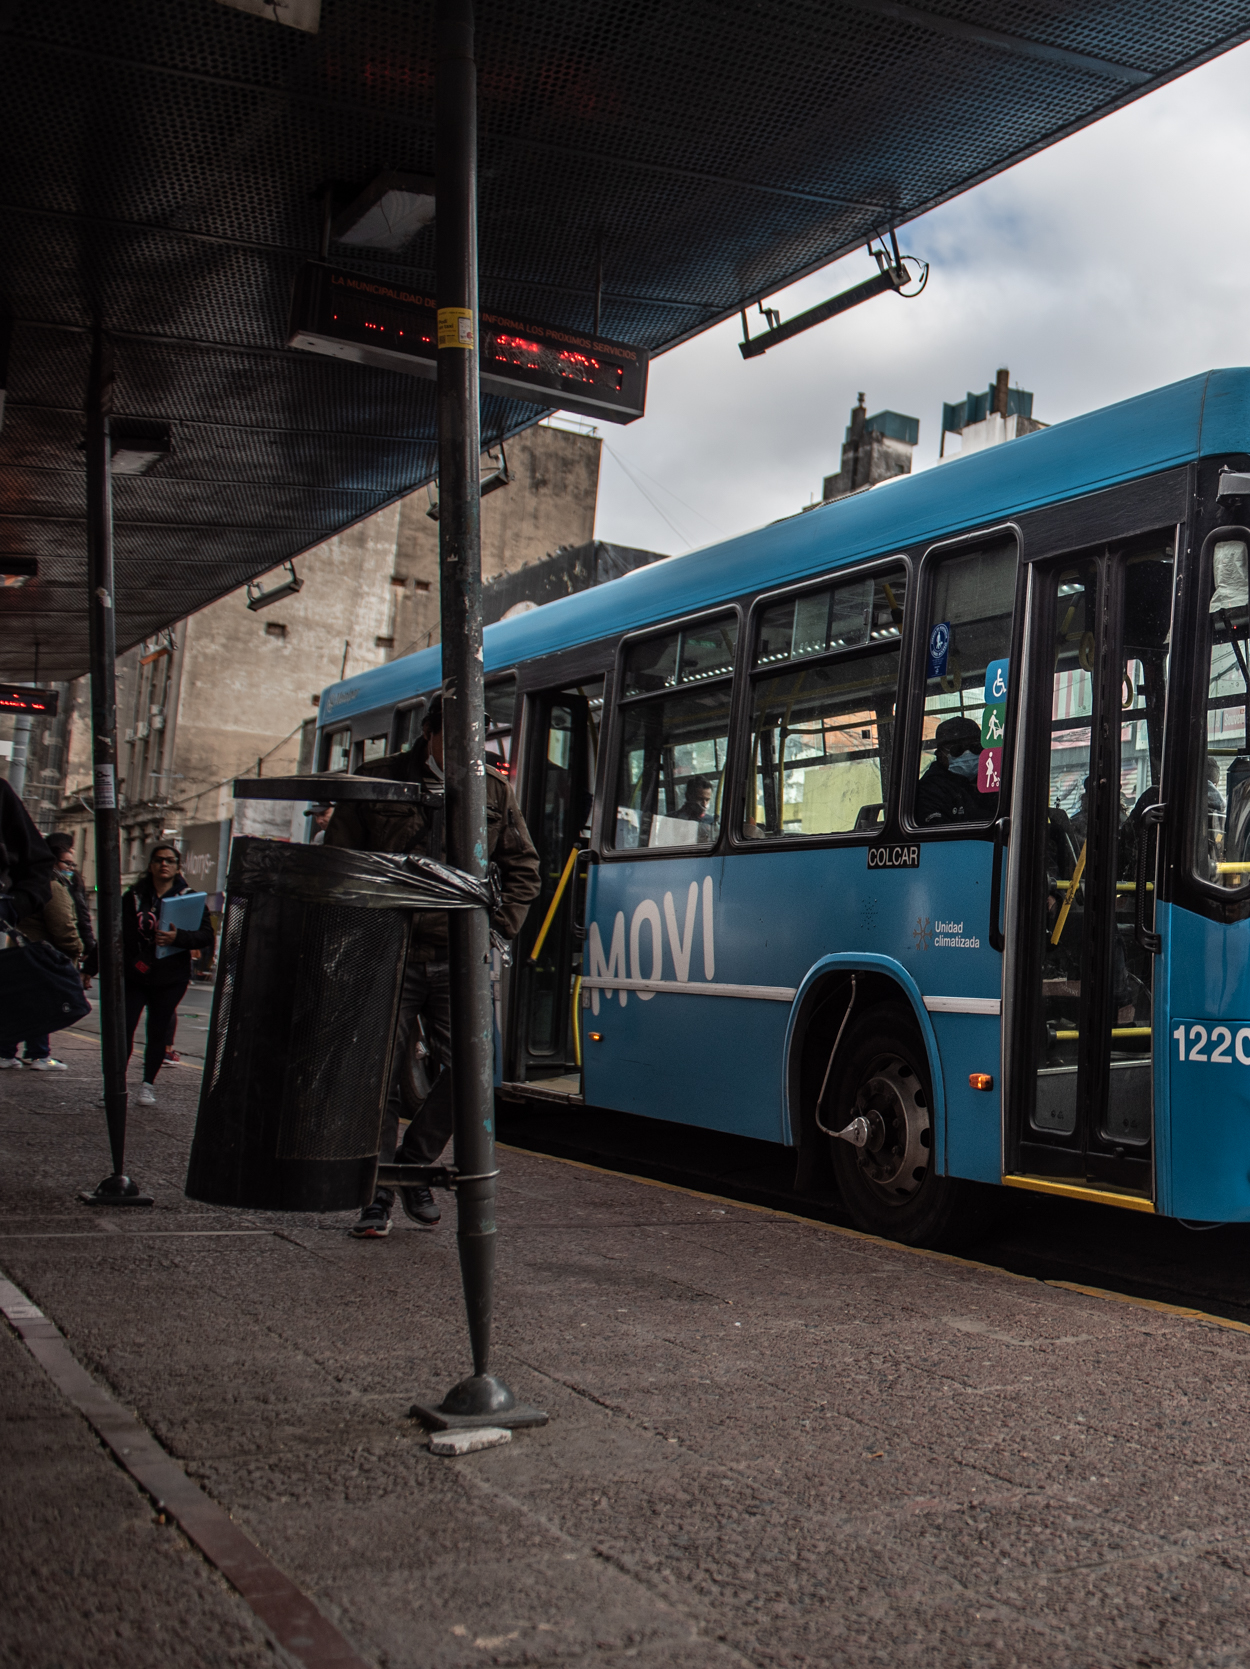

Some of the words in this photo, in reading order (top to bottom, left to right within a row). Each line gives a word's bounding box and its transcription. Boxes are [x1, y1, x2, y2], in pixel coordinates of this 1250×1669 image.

[331, 274, 344, 286] LA
[346, 279, 424, 308] MUNICIPALIDAD
[482, 312, 525, 332] INFORMA
[525, 322, 545, 337] LOS
[591, 339, 638, 362] SERVICIOS
[868, 846, 919, 868] COLCAR
[934, 920, 964, 934] Unidad
[588, 875, 714, 1016] MOVI
[934, 935, 980, 949] climatizada
